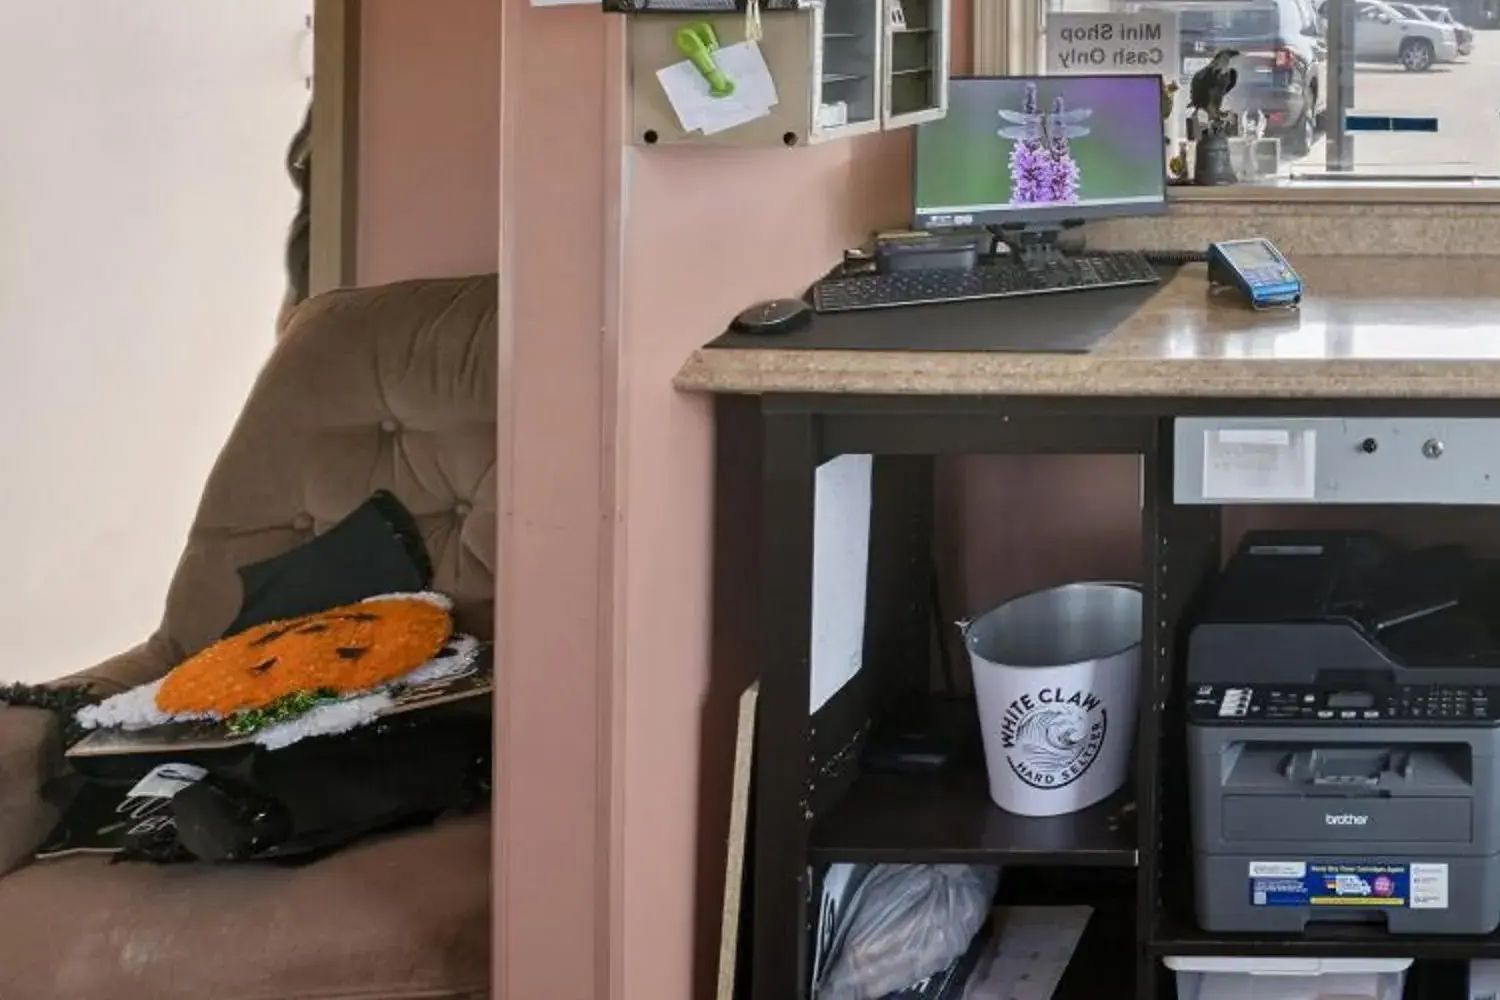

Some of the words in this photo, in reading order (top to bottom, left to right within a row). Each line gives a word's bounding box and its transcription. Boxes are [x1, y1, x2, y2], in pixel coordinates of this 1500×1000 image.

[1001, 693, 1036, 749] WHITE
[1038, 687, 1102, 713] CLAW
[1017, 761, 1055, 785] HARD
[1325, 812, 1369, 825] brother
